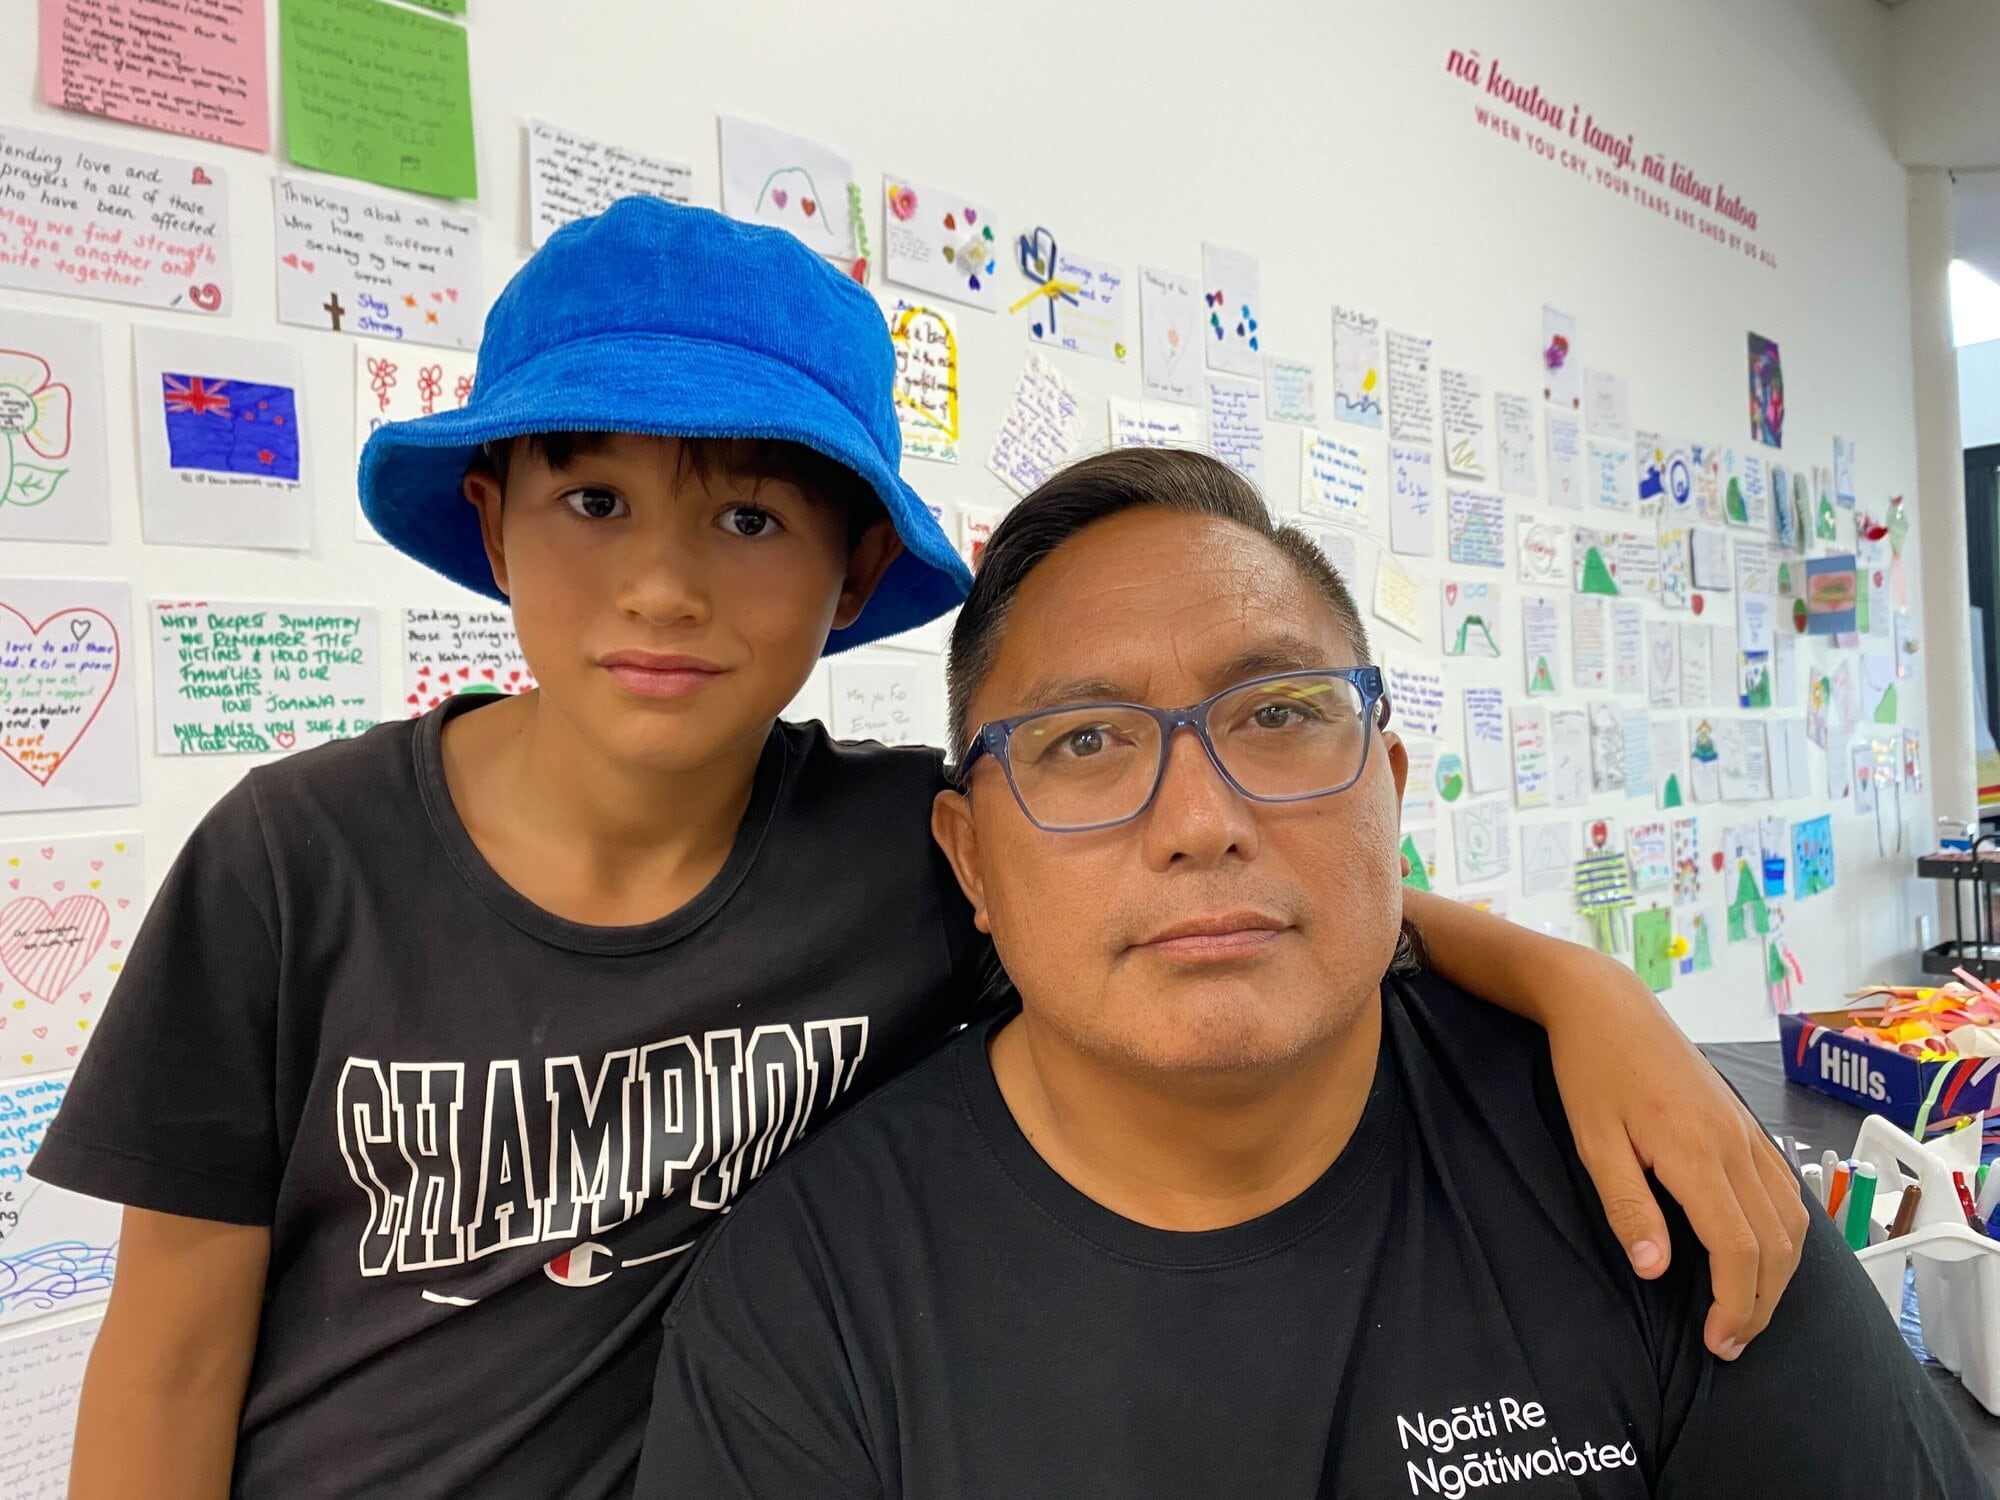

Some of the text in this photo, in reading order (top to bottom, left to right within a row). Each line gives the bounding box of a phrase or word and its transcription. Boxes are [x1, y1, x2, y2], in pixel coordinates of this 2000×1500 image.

[1446, 49, 1481, 87] nā
[1486, 59, 1564, 131] koutou
[1569, 103, 1580, 139] i
[1641, 152, 1666, 185] nā
[1715, 183, 1759, 232] katoa
[0, 143, 163, 184] ending love and
[0, 161, 69, 188] prayers
[83, 177, 98, 193] to
[107, 183, 131, 199] all
[142, 189, 159, 206] of
[1475, 105, 1522, 144] WHEN
[1526, 131, 1556, 161] YOU
[1595, 166, 1631, 198] YOUR
[1633, 185, 1671, 218] TEARS
[1674, 206, 1696, 230] ARE
[40, 189, 79, 211] have
[97, 200, 136, 220] been
[151, 212, 217, 237] affected
[281, 181, 350, 224] Thinking
[23, 233, 197, 279] one another and
[47, 221, 75, 237] we
[83, 221, 123, 246] find
[134, 234, 217, 265] strength
[407, 609, 461, 629] Sending
[1396, 1400, 1498, 1453] Ngāti
